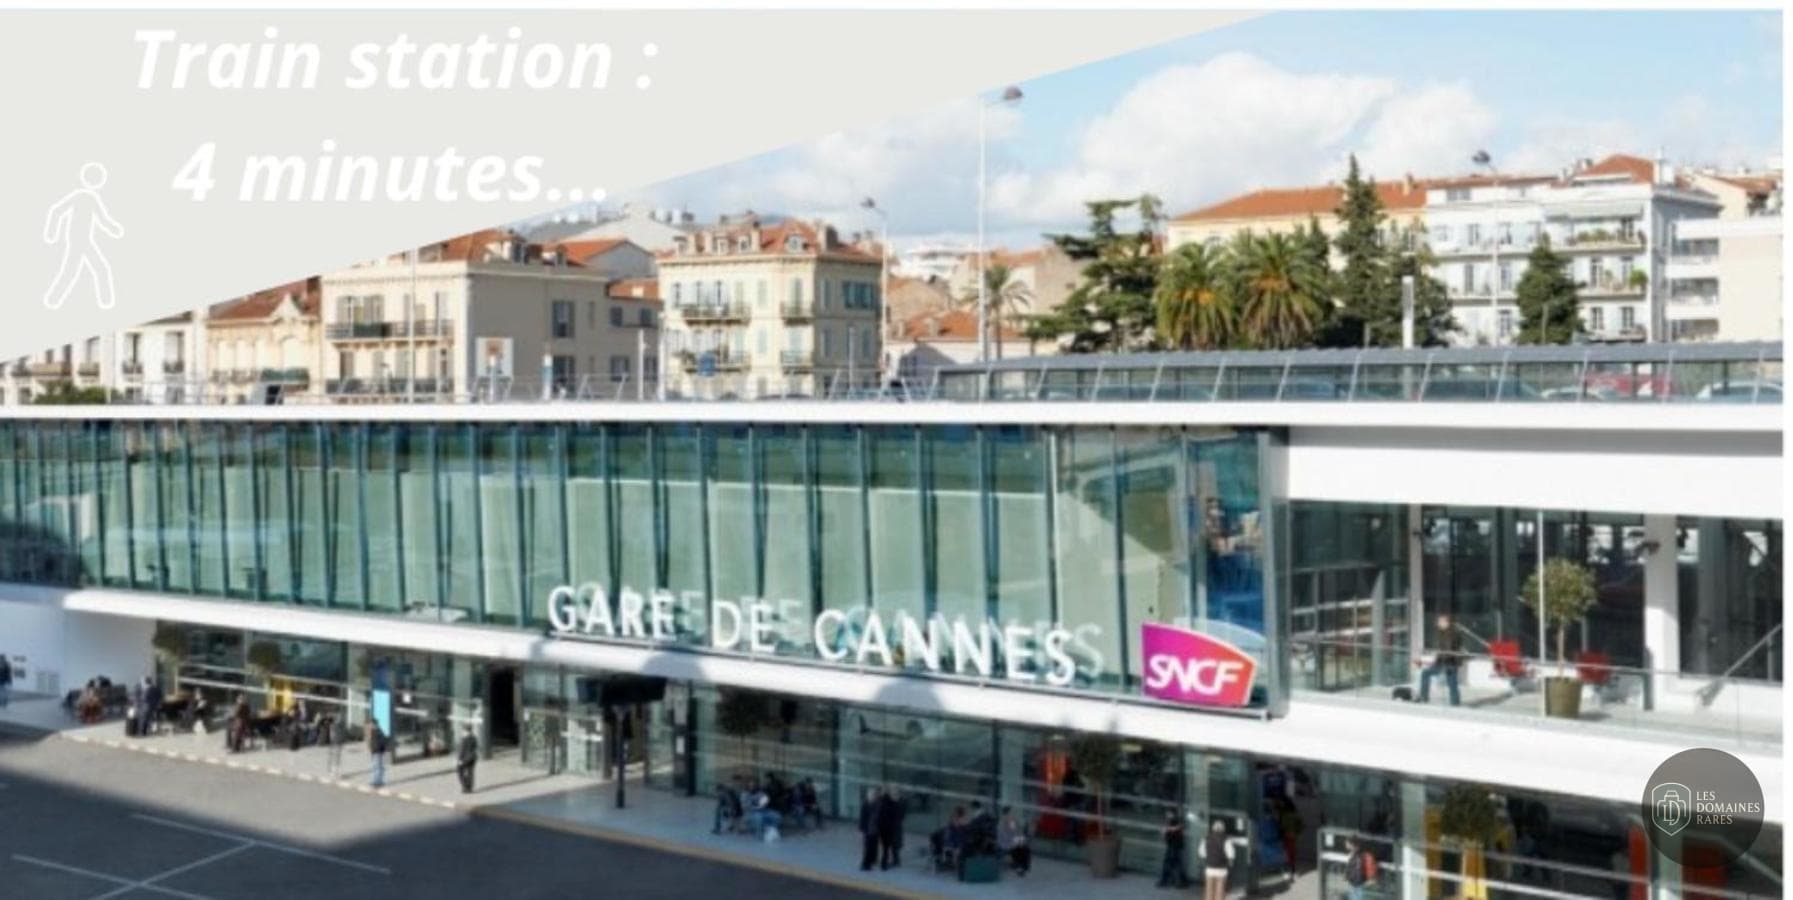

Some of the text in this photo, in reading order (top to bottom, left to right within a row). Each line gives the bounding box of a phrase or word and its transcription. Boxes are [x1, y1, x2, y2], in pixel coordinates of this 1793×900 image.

[548, 585, 1077, 686] GARE DE CANNES
[1146, 653, 1244, 696] SNCF
